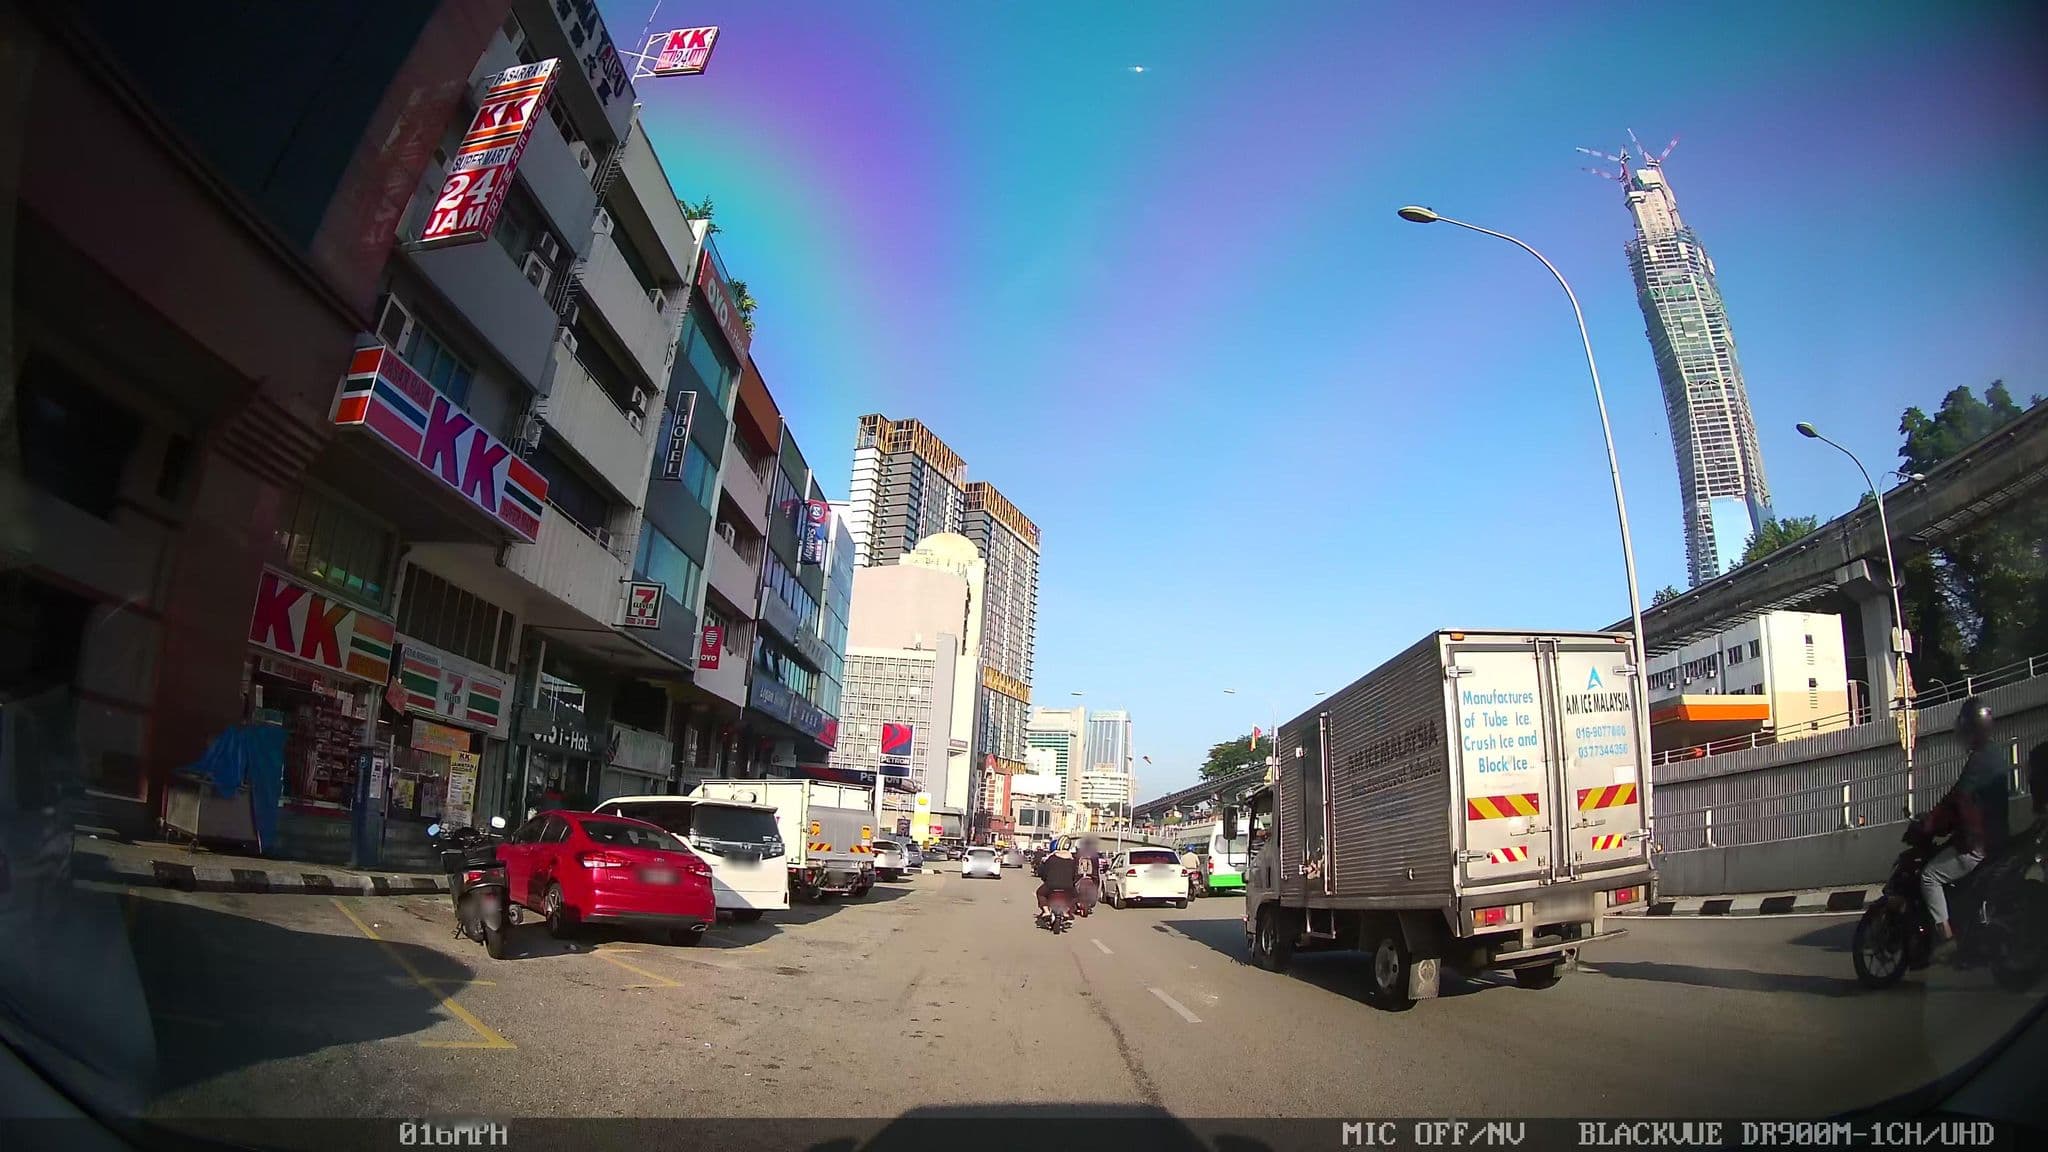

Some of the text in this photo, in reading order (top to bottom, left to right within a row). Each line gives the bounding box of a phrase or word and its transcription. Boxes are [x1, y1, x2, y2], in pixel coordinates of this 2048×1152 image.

[668, 29, 712, 50] KK
[471, 98, 533, 131] KK
[451, 147, 512, 172] SUPERMART
[434, 168, 498, 212] 24
[424, 205, 484, 234] JAM
[708, 277, 728, 328] OYO
[420, 396, 510, 513] KK
[667, 414, 687, 475] HOTEL
[635, 589, 655, 617] 7
[251, 573, 354, 668] KK
[700, 654, 717, 662] OYO
[1463, 689, 1534, 706] Manufactures
[1566, 692, 1631, 715] AM ICE MALAYSIA
[1464, 712, 1475, 728] of
[1482, 710, 1508, 727] Tube
[1464, 730, 1538, 752] Crush Ice and
[880, 756, 910, 765] PETRON
[1478, 755, 1528, 773] Block Ice
